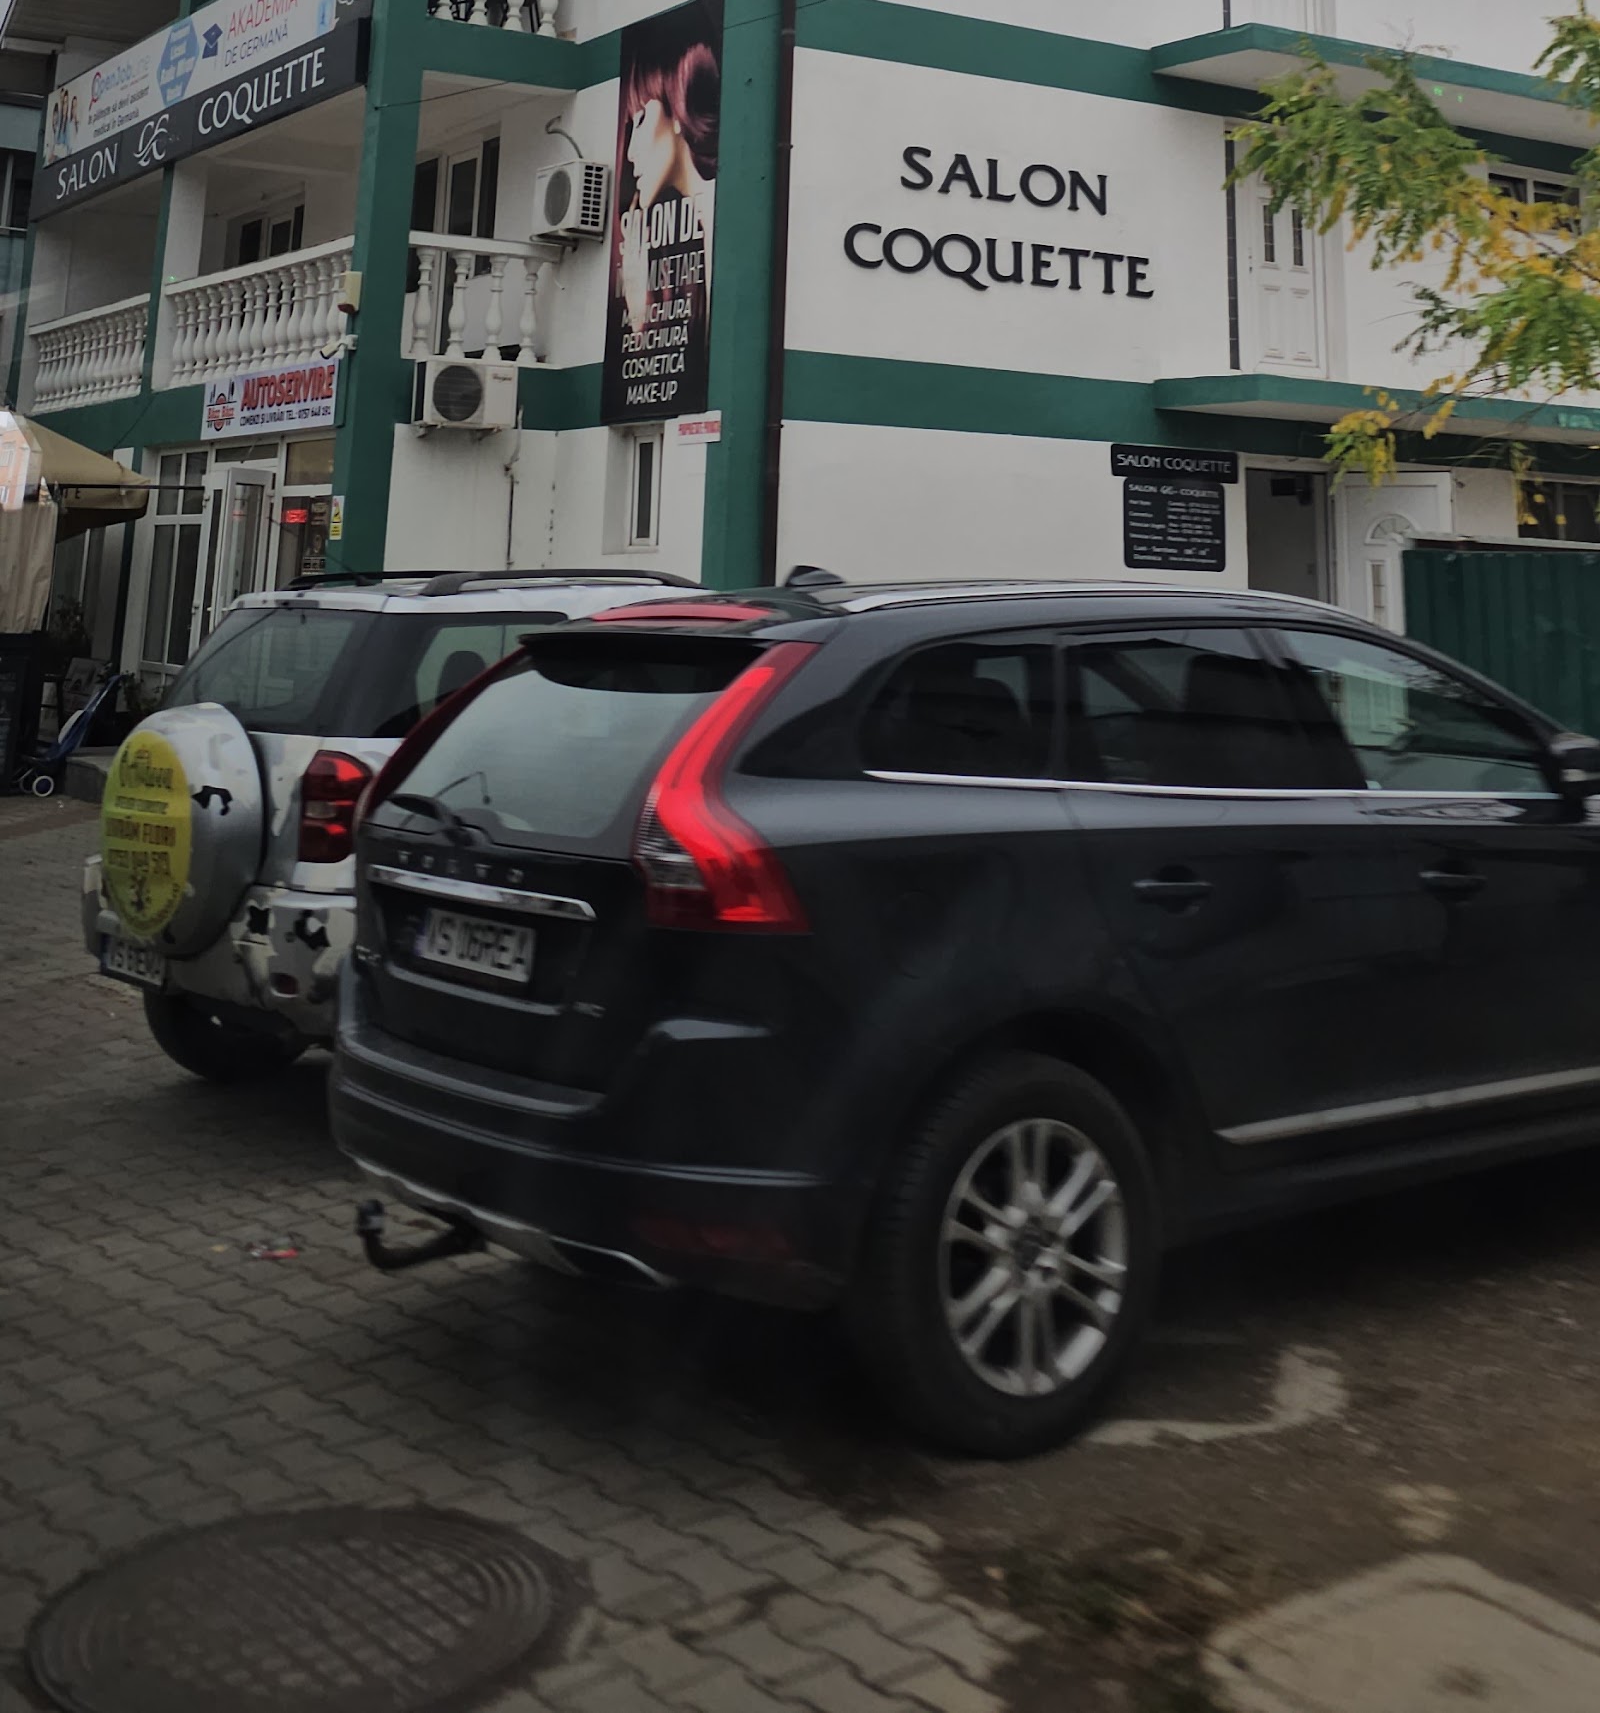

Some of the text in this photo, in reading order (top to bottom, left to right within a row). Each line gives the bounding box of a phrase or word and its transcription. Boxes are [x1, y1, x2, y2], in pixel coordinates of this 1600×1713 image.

[225, 44, 238, 68] DE
[240, 18, 289, 61] GERMANĂ
[56, 142, 119, 200] SALON
[198, 47, 326, 135] COQUETTE
[901, 145, 1108, 217] SALON
[619, 191, 706, 256] SALON DE
[843, 222, 1155, 299] COQUETTE
[621, 320, 689, 354] PEDICHIURĂ
[621, 347, 686, 380] COSMETICĂ
[240, 364, 335, 412] AUTOSERVIRE
[626, 380, 679, 406] MAKE-UP
[240, 414, 259, 426] COMENZI
[1116, 453, 1232, 474] SALON COQUETTE
[1128, 484, 1158, 493] SALON
